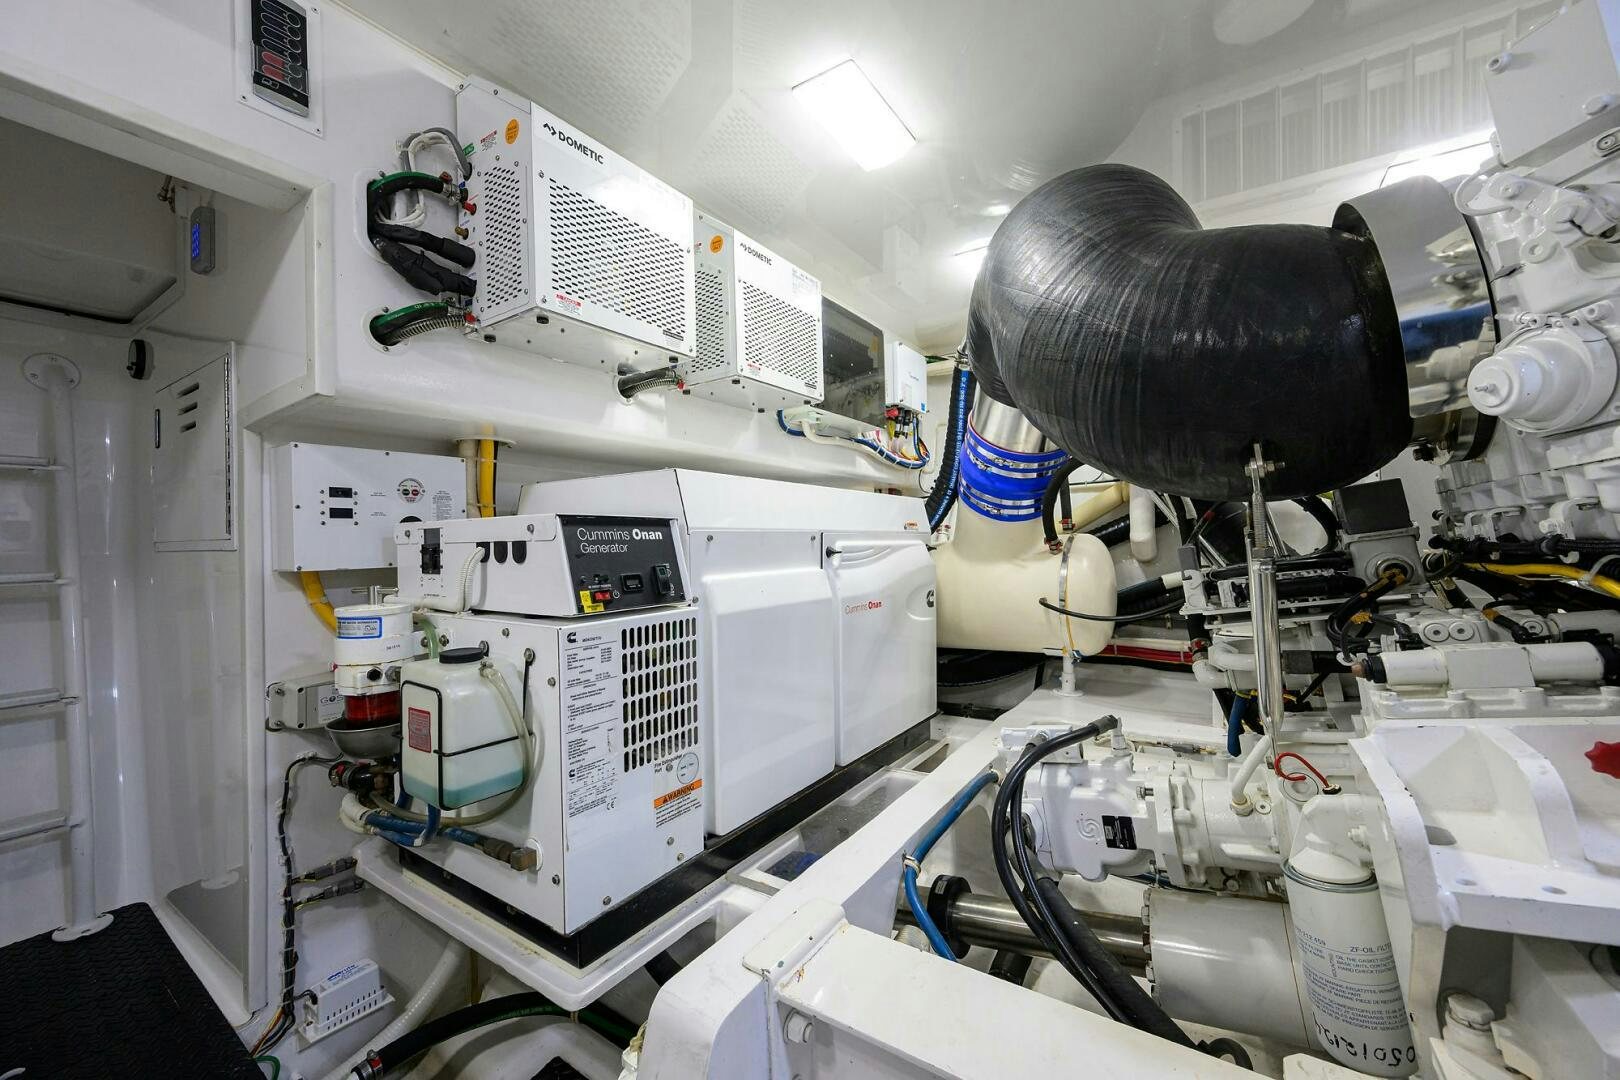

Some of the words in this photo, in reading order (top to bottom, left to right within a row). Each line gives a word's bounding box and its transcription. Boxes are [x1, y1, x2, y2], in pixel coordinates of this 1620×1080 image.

[558, 131, 604, 165] DOMETIC
[747, 246, 772, 266] DOMETIC
[577, 528, 630, 541] Cummins
[632, 529, 663, 540] Onan
[580, 542, 629, 553] Generator
[845, 602, 868, 614] Cummins
[868, 601, 882, 609] Onan
[667, 783, 695, 802] WARNING
